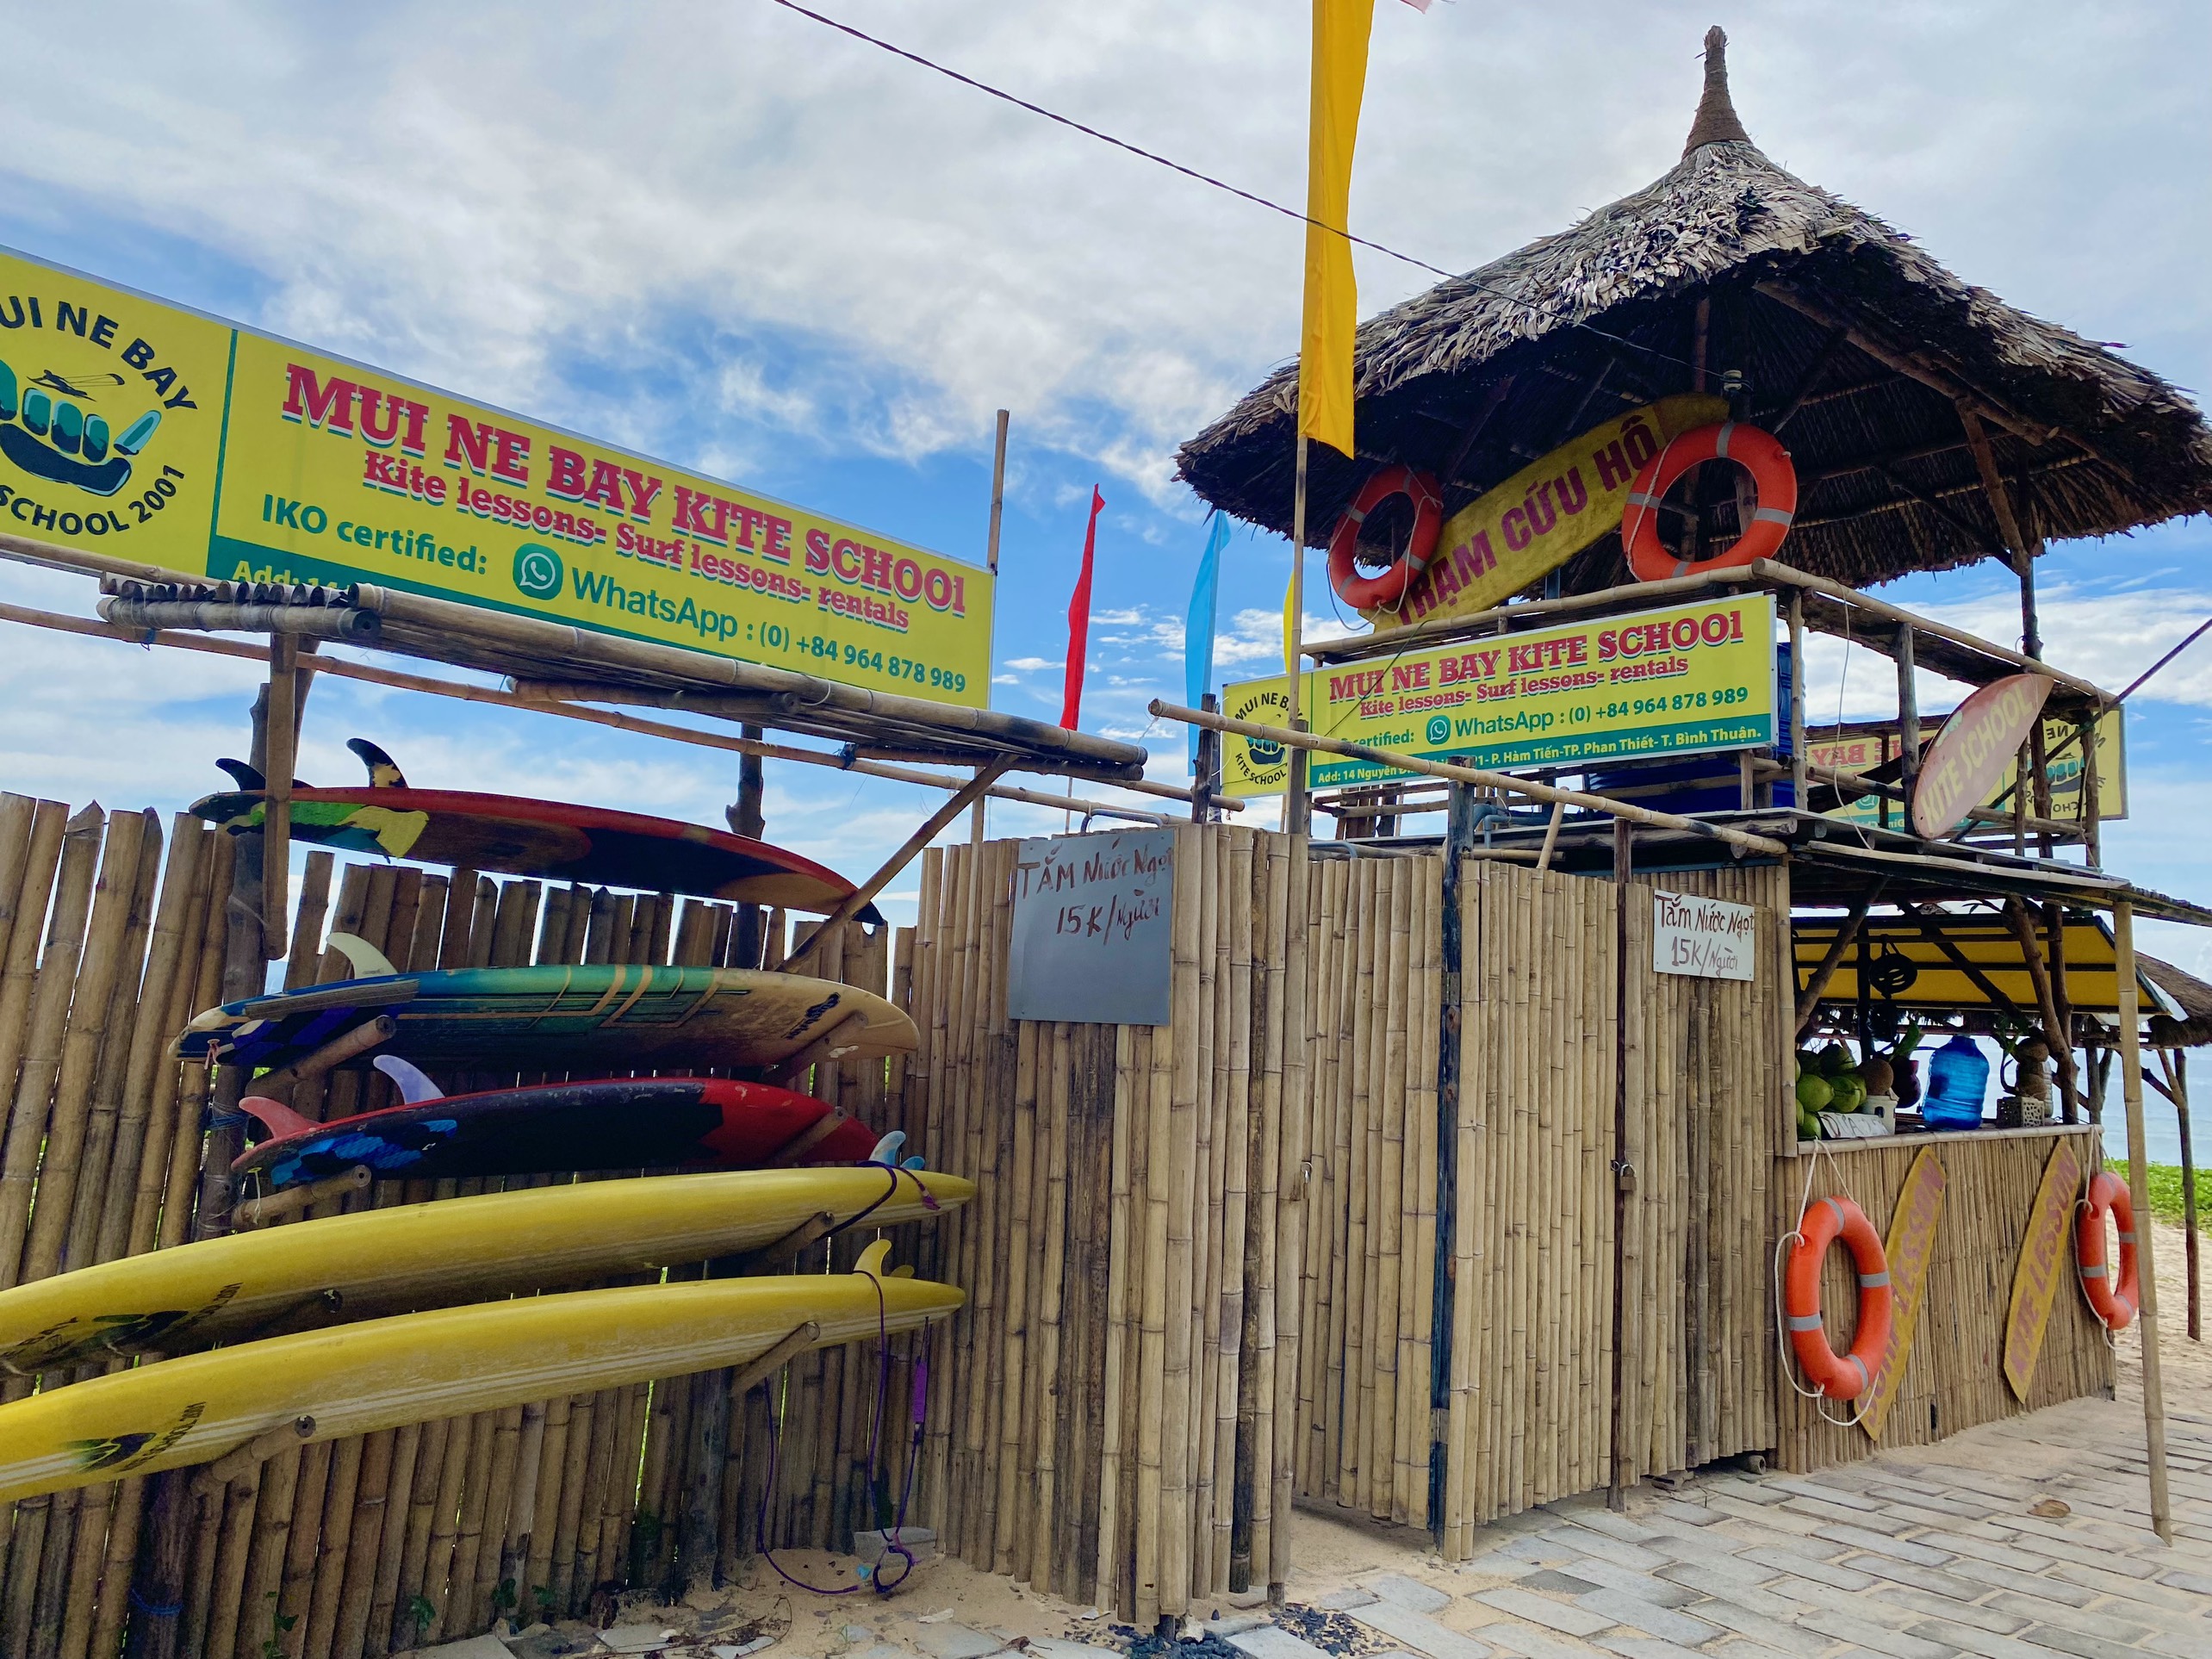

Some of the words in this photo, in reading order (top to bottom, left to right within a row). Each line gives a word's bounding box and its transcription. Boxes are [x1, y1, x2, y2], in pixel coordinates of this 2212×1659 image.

[0, 296, 42, 328] UI
[57, 301, 119, 350] NE
[121, 338, 198, 410] BAY
[128, 465, 184, 523] 2001
[282, 363, 429, 459] MUI
[444, 413, 531, 489] NE
[546, 445, 662, 525] BAY
[672, 485, 792, 566] KITE
[1501, 466, 1588, 551] CỨU
[363, 450, 447, 506] Kite
[457, 476, 606, 547] lessons-
[616, 523, 685, 572] Surf
[690, 544, 811, 604] lessons-
[818, 587, 909, 634] rentals
[263, 494, 327, 534] IKO
[337, 521, 487, 575] certified:
[572, 568, 737, 642] WhatsApp
[796, 636, 838, 661] +84
[844, 645, 882, 672] 964
[888, 656, 925, 683] 878
[930, 668, 966, 693] 989
[1330, 669, 1386, 704] MUI
[1392, 662, 1431, 694] NE
[1438, 649, 1501, 687] BAY
[1508, 635, 1588, 676] KITE
[1360, 699, 1395, 720] Kite
[1399, 688, 1472, 716] lessons-
[1476, 679, 1518, 703] Surf
[1520, 668, 1605, 699] lessons-
[1611, 656, 1689, 685] rentals
[1235, 696, 1258, 721] MUI
[1261, 693, 1278, 705] NE
[1455, 711, 1554, 738] WhatsApp
[1596, 701, 1628, 718] +84
[1633, 697, 1668, 715] 964
[1672, 692, 1706, 711] 878
[1712, 687, 1749, 705] 989
[1235, 753, 1251, 777] KITE
[1249, 769, 1287, 785] SCHOOL
[1318, 770, 1341, 783] Add:
[1343, 769, 1355, 780] 14
[1504, 749, 1531, 762] Hàm
[1584, 742, 1617, 755] Phan
[1676, 730, 1707, 745] Bình
[1920, 758, 1964, 834] KITE
[1960, 683, 2034, 780] SCHOOL
[1017, 842, 1076, 900] TẮM
[1655, 894, 1693, 930] Tắm
[1694, 903, 1725, 933] Nước
[1726, 910, 1755, 943] Ngọt
[2029, 1146, 2079, 1296] LESSON
